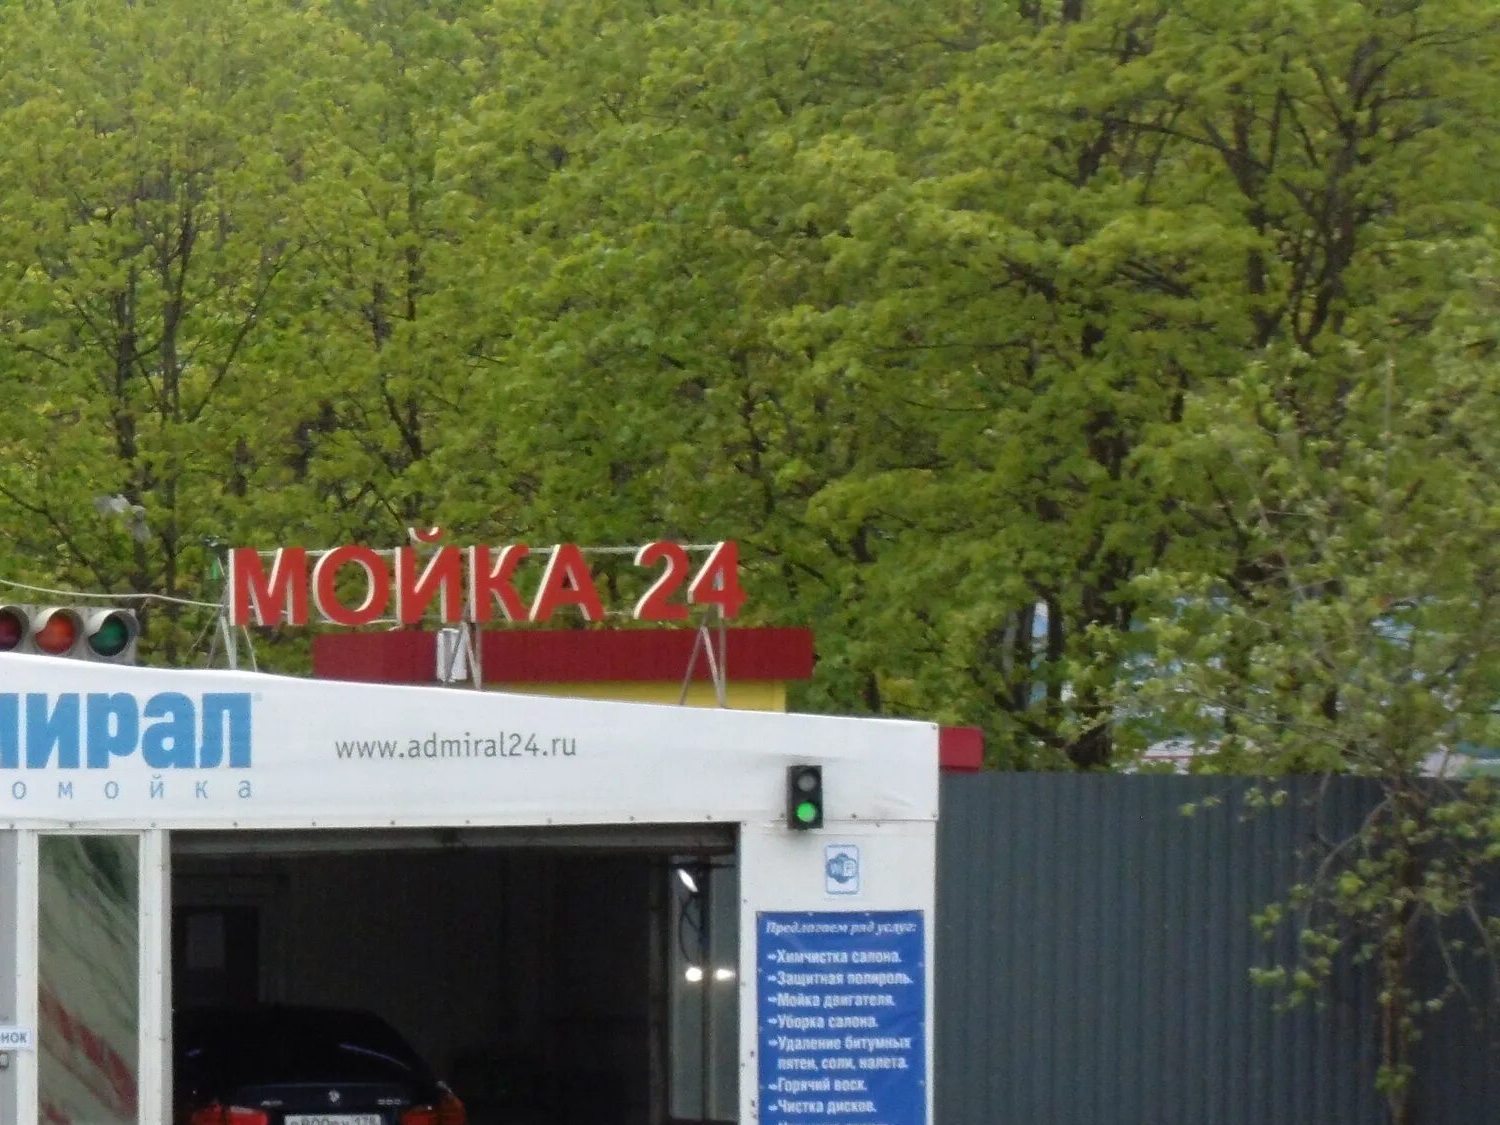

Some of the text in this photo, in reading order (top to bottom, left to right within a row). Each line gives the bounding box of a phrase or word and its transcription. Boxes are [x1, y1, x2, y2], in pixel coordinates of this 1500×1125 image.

[229, 527, 747, 627] МОЙКА 24
[335, 730, 577, 760] www.admiral24.ru
[851, 922, 874, 936] ряд
[776, 950, 902, 963] Химчистка салона.
[777, 972, 844, 985] Защитная
[778, 993, 820, 1006] Мойка
[778, 1015, 878, 1029] Уборка салона.
[778, 1036, 911, 1052] Удаление битумных
[778, 1078, 830, 1092] Горячий
[778, 1099, 824, 1112] Чистка
